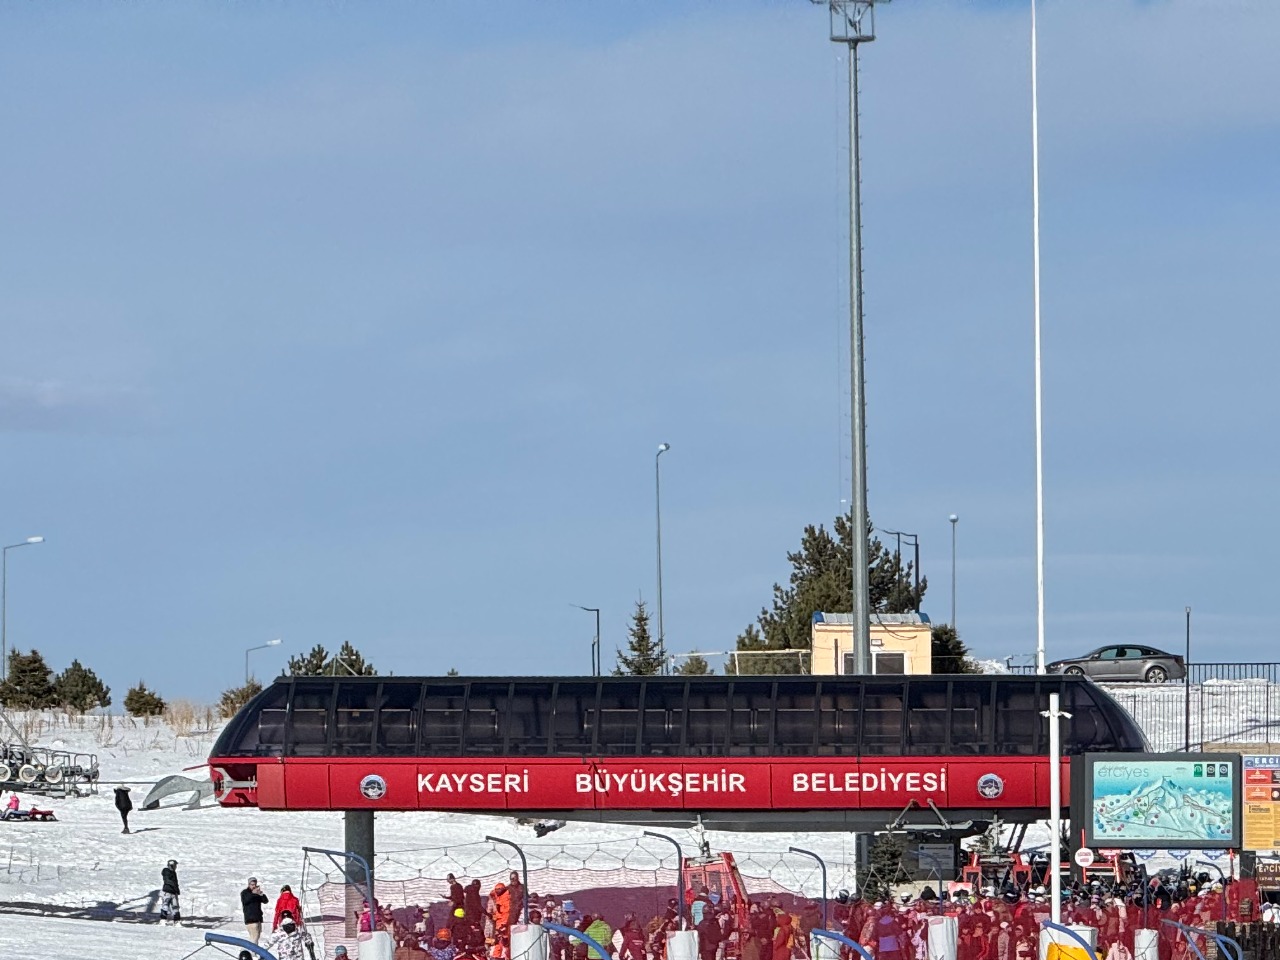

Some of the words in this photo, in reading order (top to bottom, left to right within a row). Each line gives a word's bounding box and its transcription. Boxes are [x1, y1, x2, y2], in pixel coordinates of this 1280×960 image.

[417, 769, 530, 793] KAYSERİ
[575, 767, 746, 797] BÜYÜKŞEHİR
[792, 767, 947, 793] BELEDİYESİ
[1097, 766, 1150, 780] erciyes
